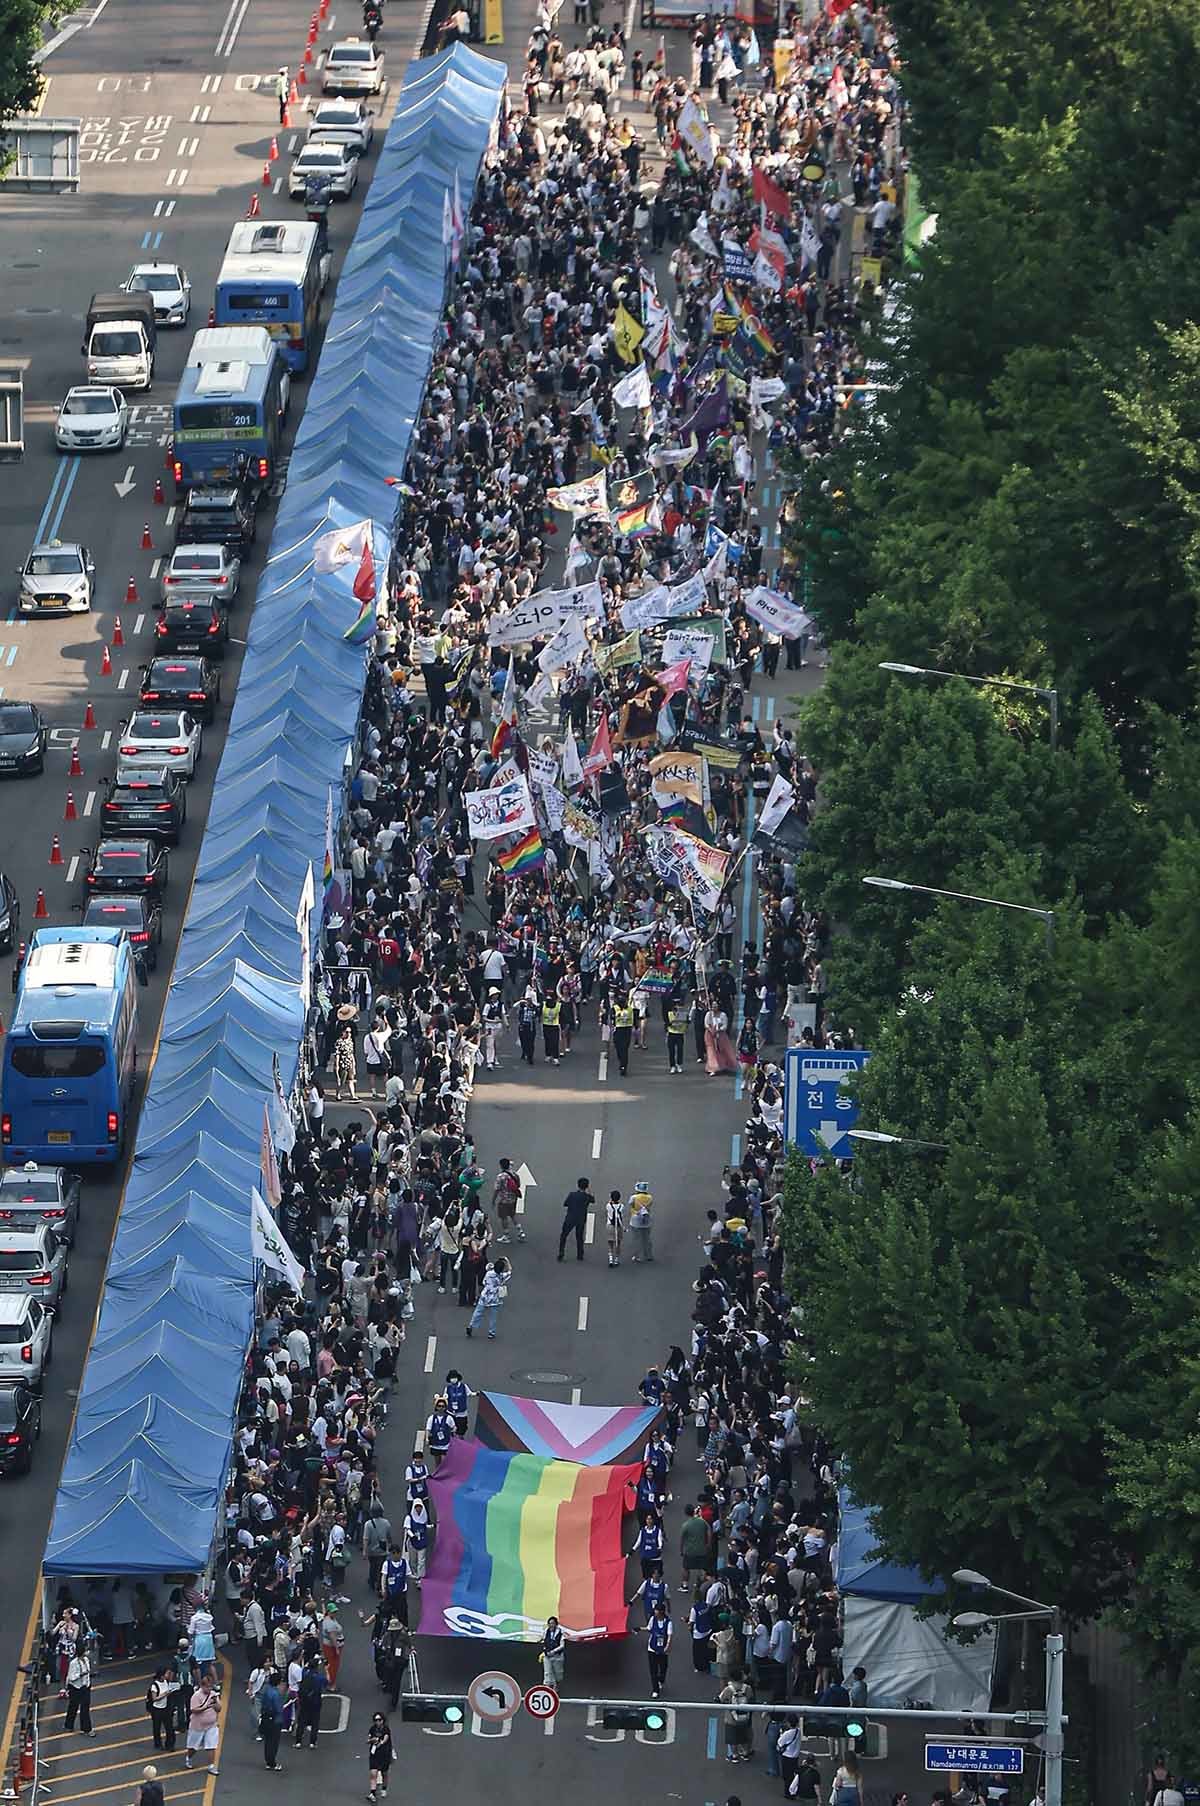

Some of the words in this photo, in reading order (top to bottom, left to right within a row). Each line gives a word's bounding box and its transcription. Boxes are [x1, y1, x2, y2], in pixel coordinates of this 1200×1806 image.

[234, 416, 251, 425] 201
[381, 944, 392, 955] 16
[531, 1694, 551, 1711] 50
[946, 1748, 990, 1760] 남대문로
